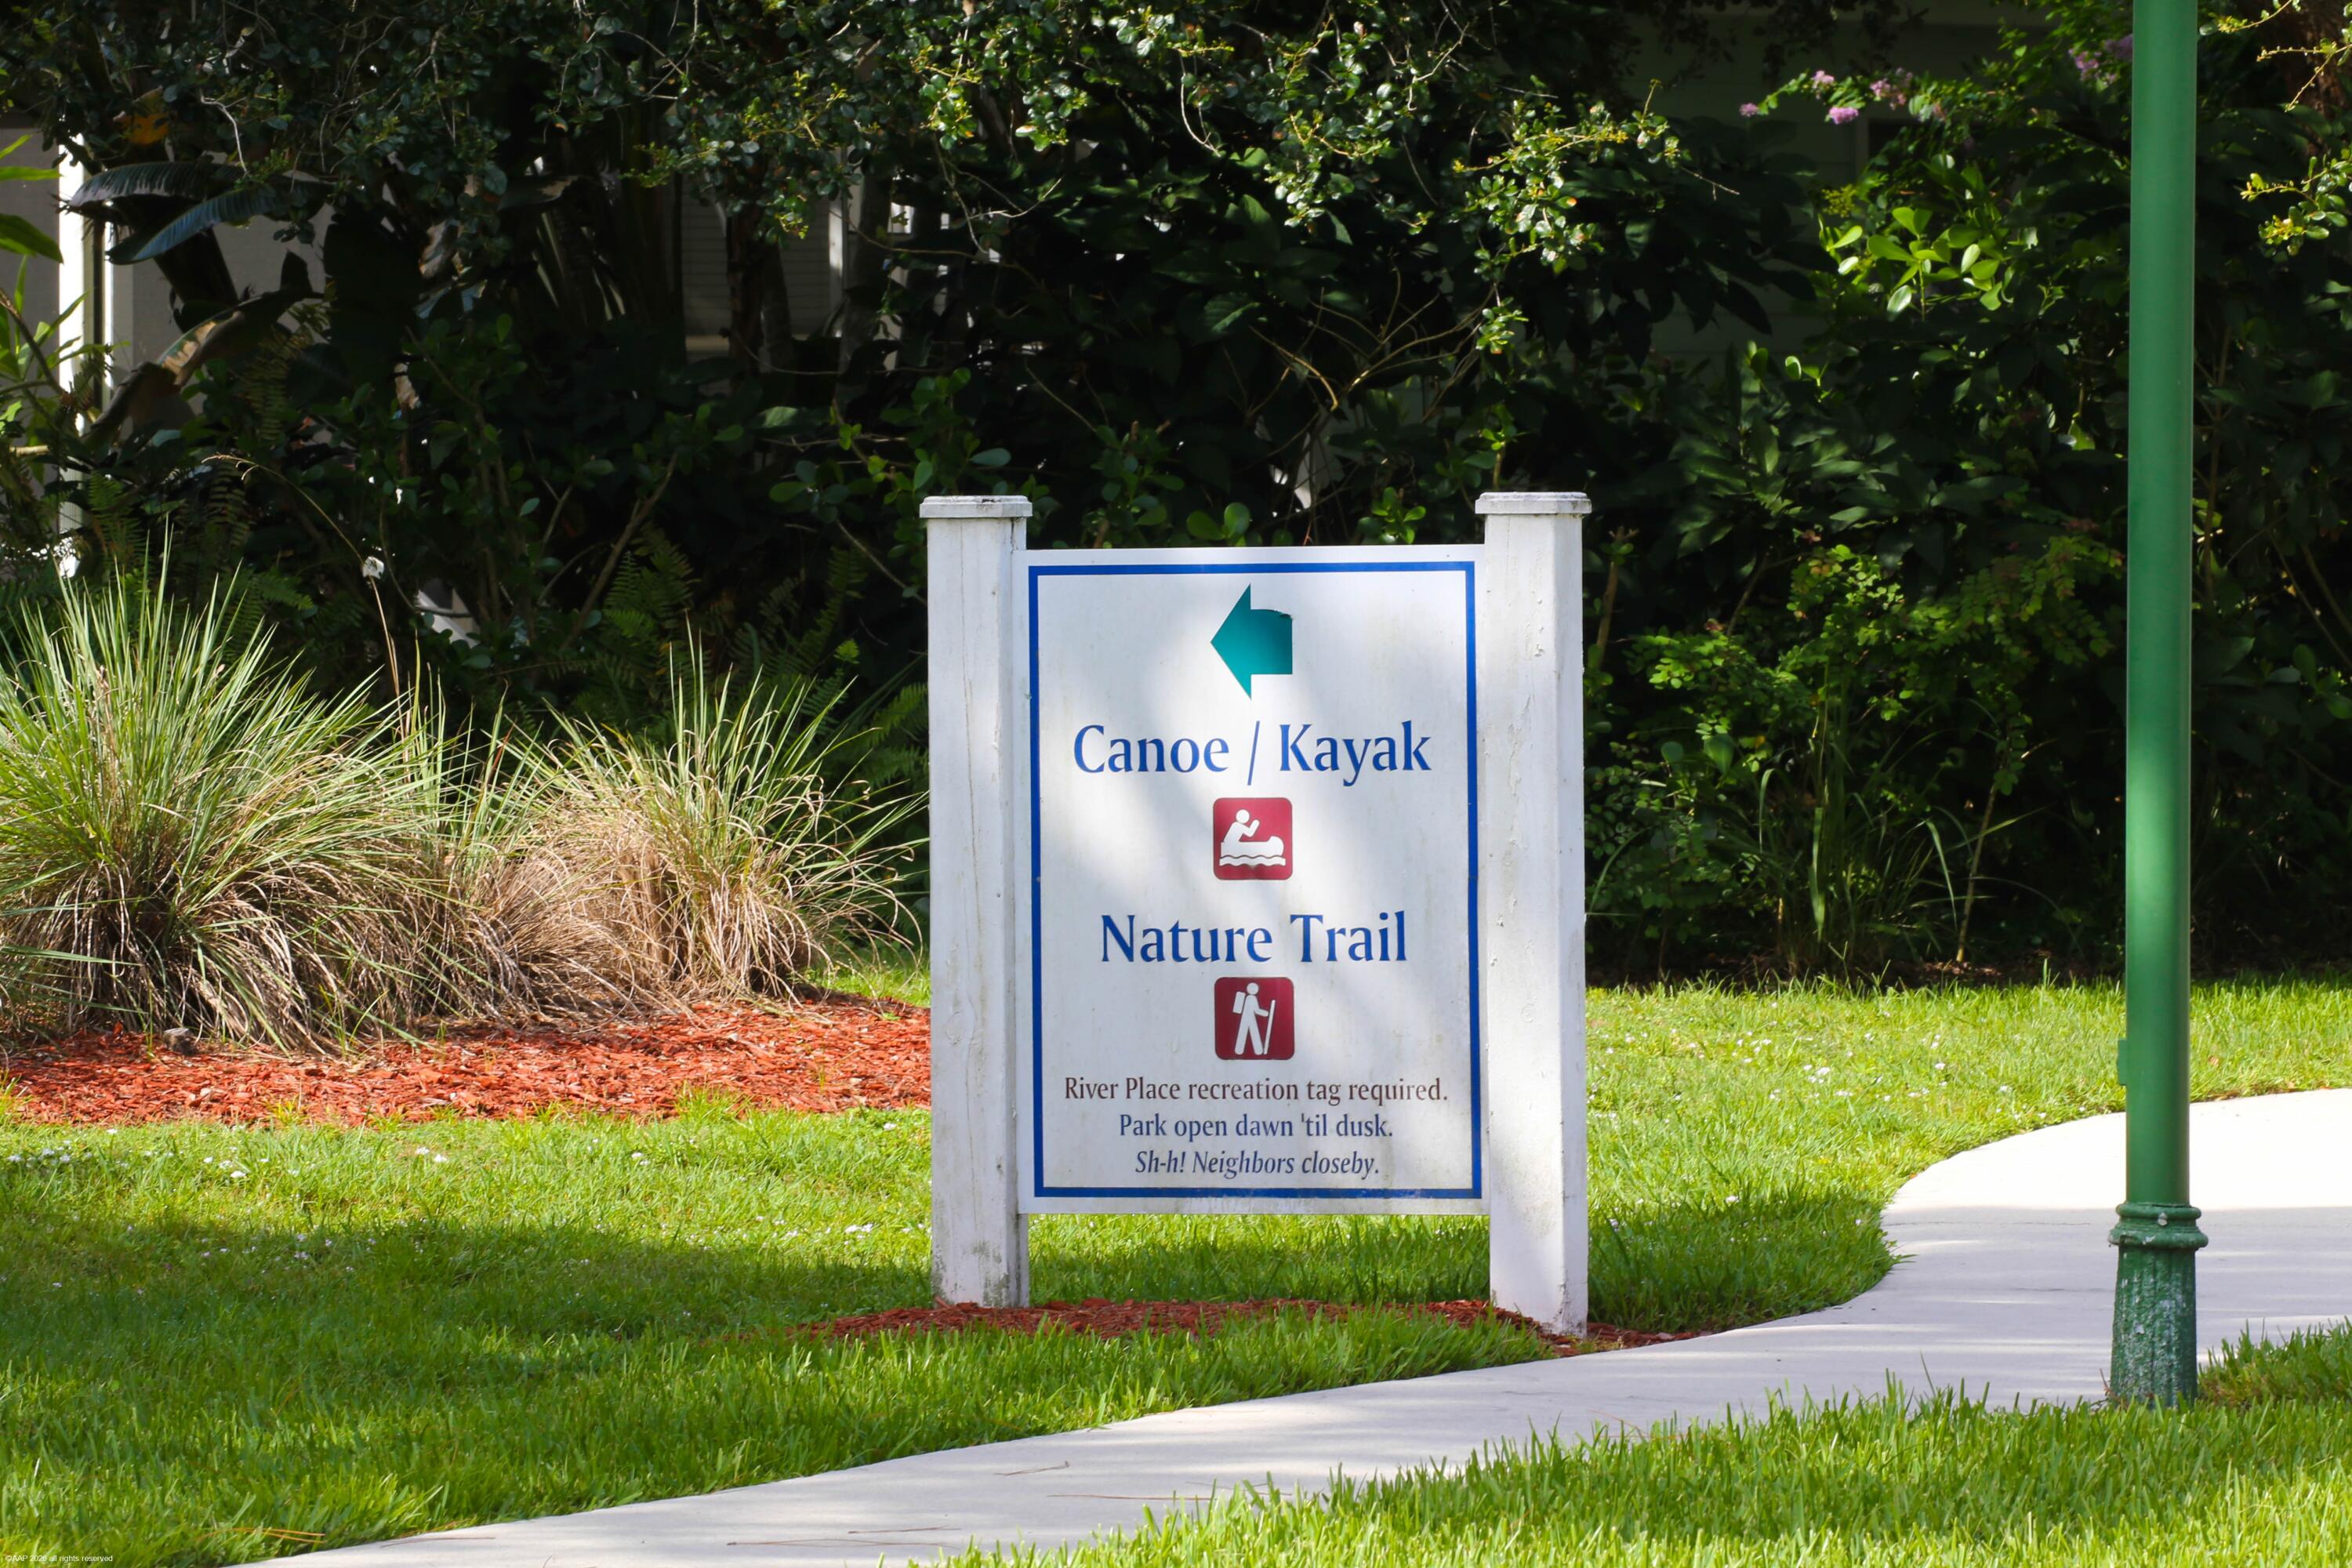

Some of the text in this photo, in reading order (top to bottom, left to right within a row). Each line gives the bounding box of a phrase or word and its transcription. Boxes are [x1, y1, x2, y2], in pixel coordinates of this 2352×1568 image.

[1074, 720, 1432, 787] Canoe / Kayak
[1101, 909, 1407, 963] Nature Trail
[1065, 1076, 1447, 1106] River Place recreation tag required.
[1120, 1113, 1392, 1142] Park open dawn 'til dusk.
[1136, 1150, 1378, 1180] Sh-h! Neighbors closeby.
